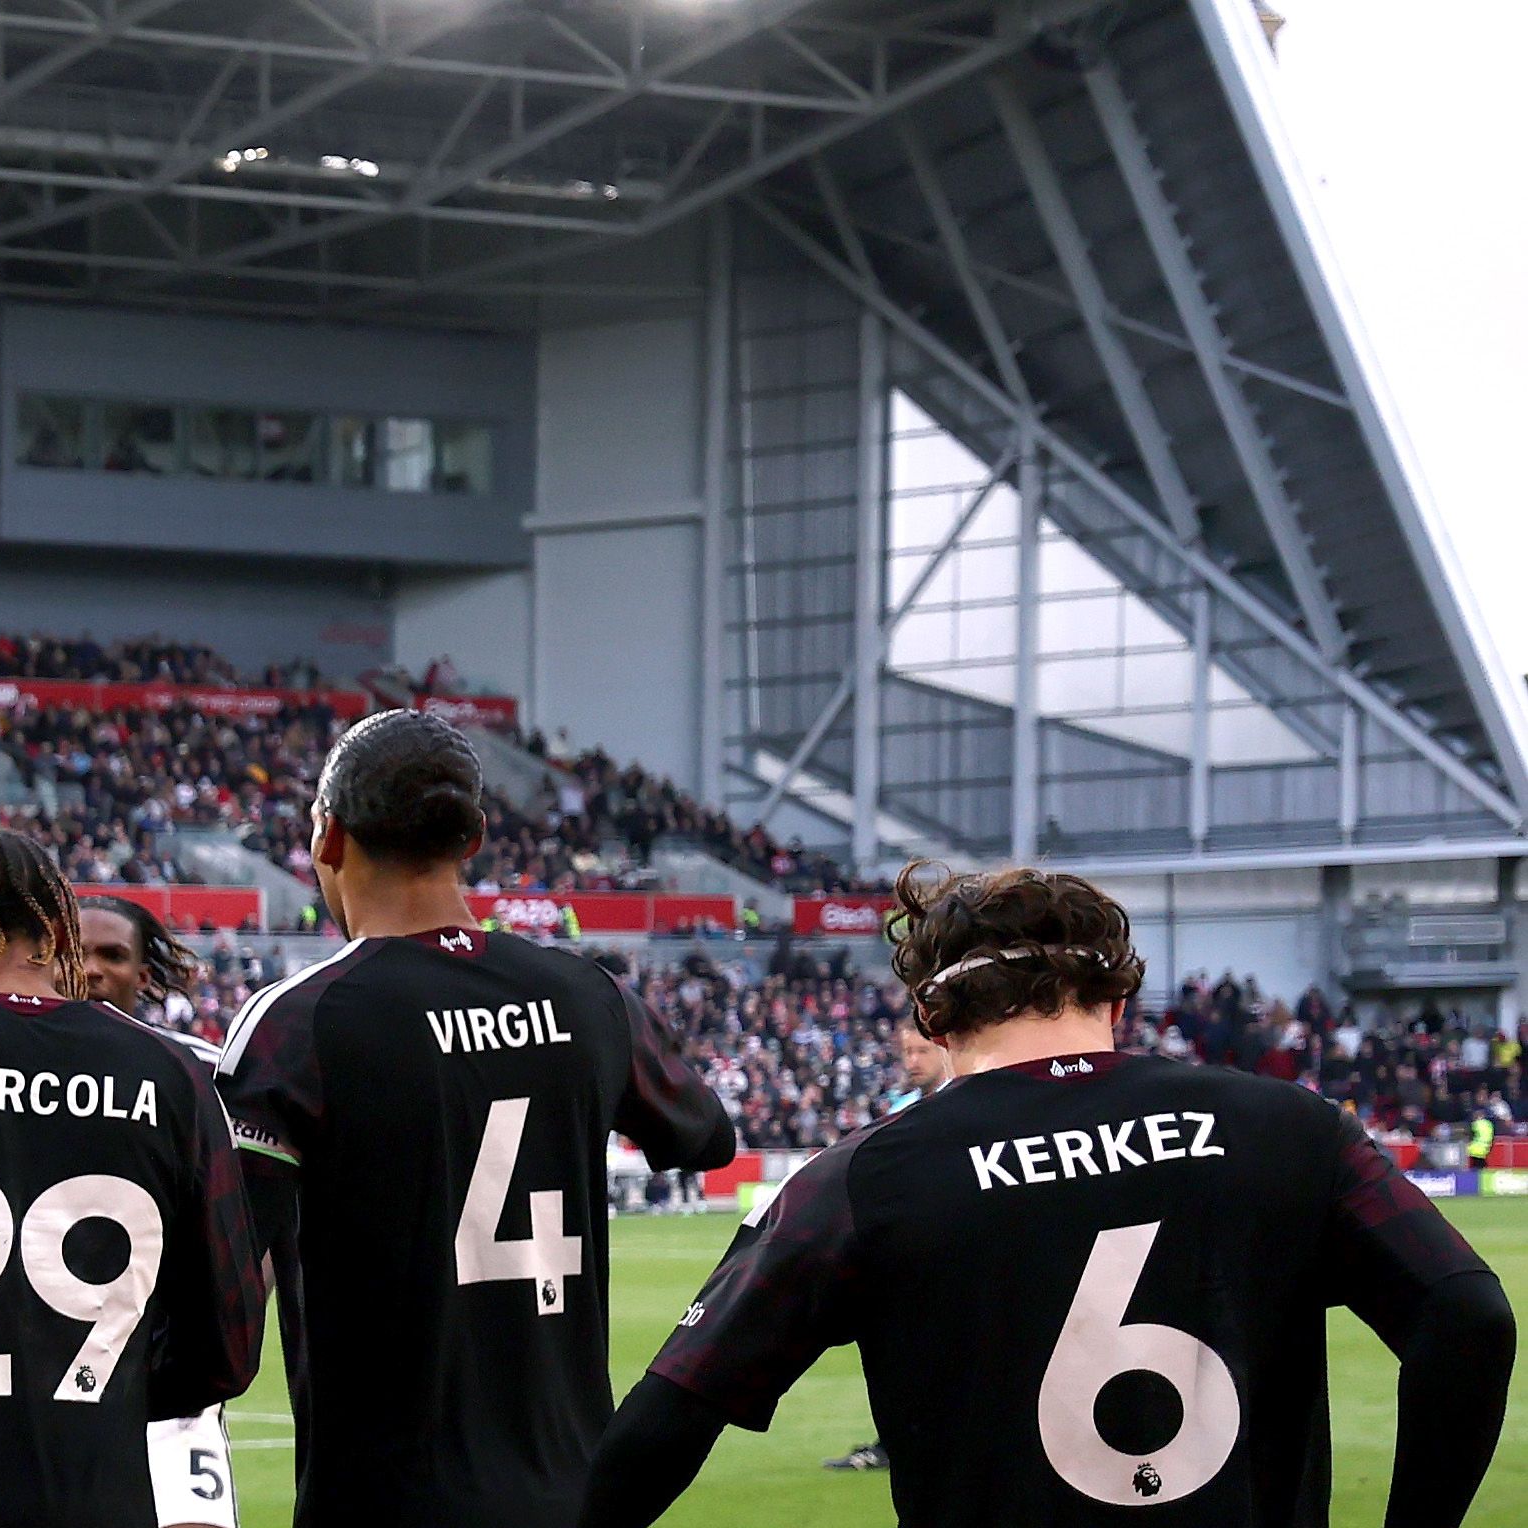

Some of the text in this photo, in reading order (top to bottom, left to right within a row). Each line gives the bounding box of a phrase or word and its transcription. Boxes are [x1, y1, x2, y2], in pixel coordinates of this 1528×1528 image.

[425, 998, 573, 1054] VIRGIL
[967, 1110, 1226, 1191] KERKEZ
[454, 1097, 582, 1316] 4
[1037, 1219, 1242, 1507] 6
[190, 1448, 225, 1501] 5
